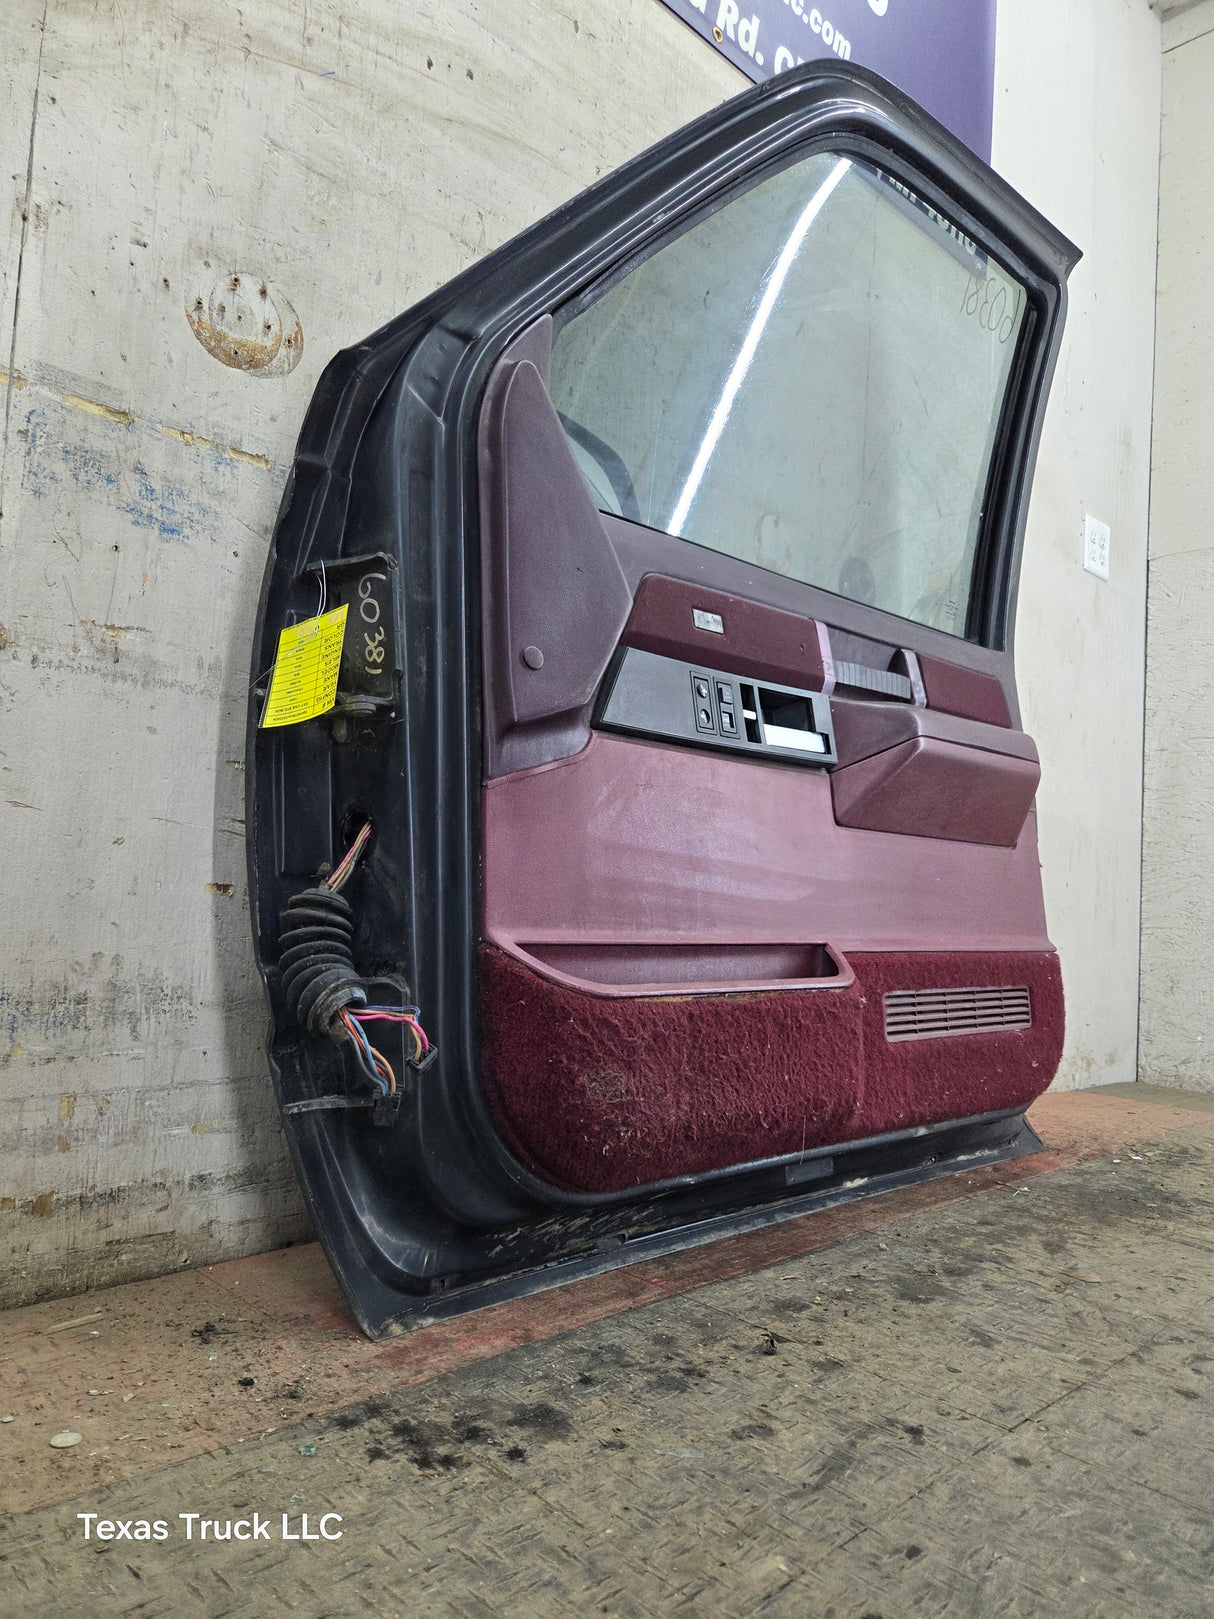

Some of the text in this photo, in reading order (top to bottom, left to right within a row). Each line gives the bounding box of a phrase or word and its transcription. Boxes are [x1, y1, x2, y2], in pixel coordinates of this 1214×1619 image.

[716, 1, 765, 66] Rd.
[783, 0, 852, 60] c.com
[358, 572, 387, 675] 60381
